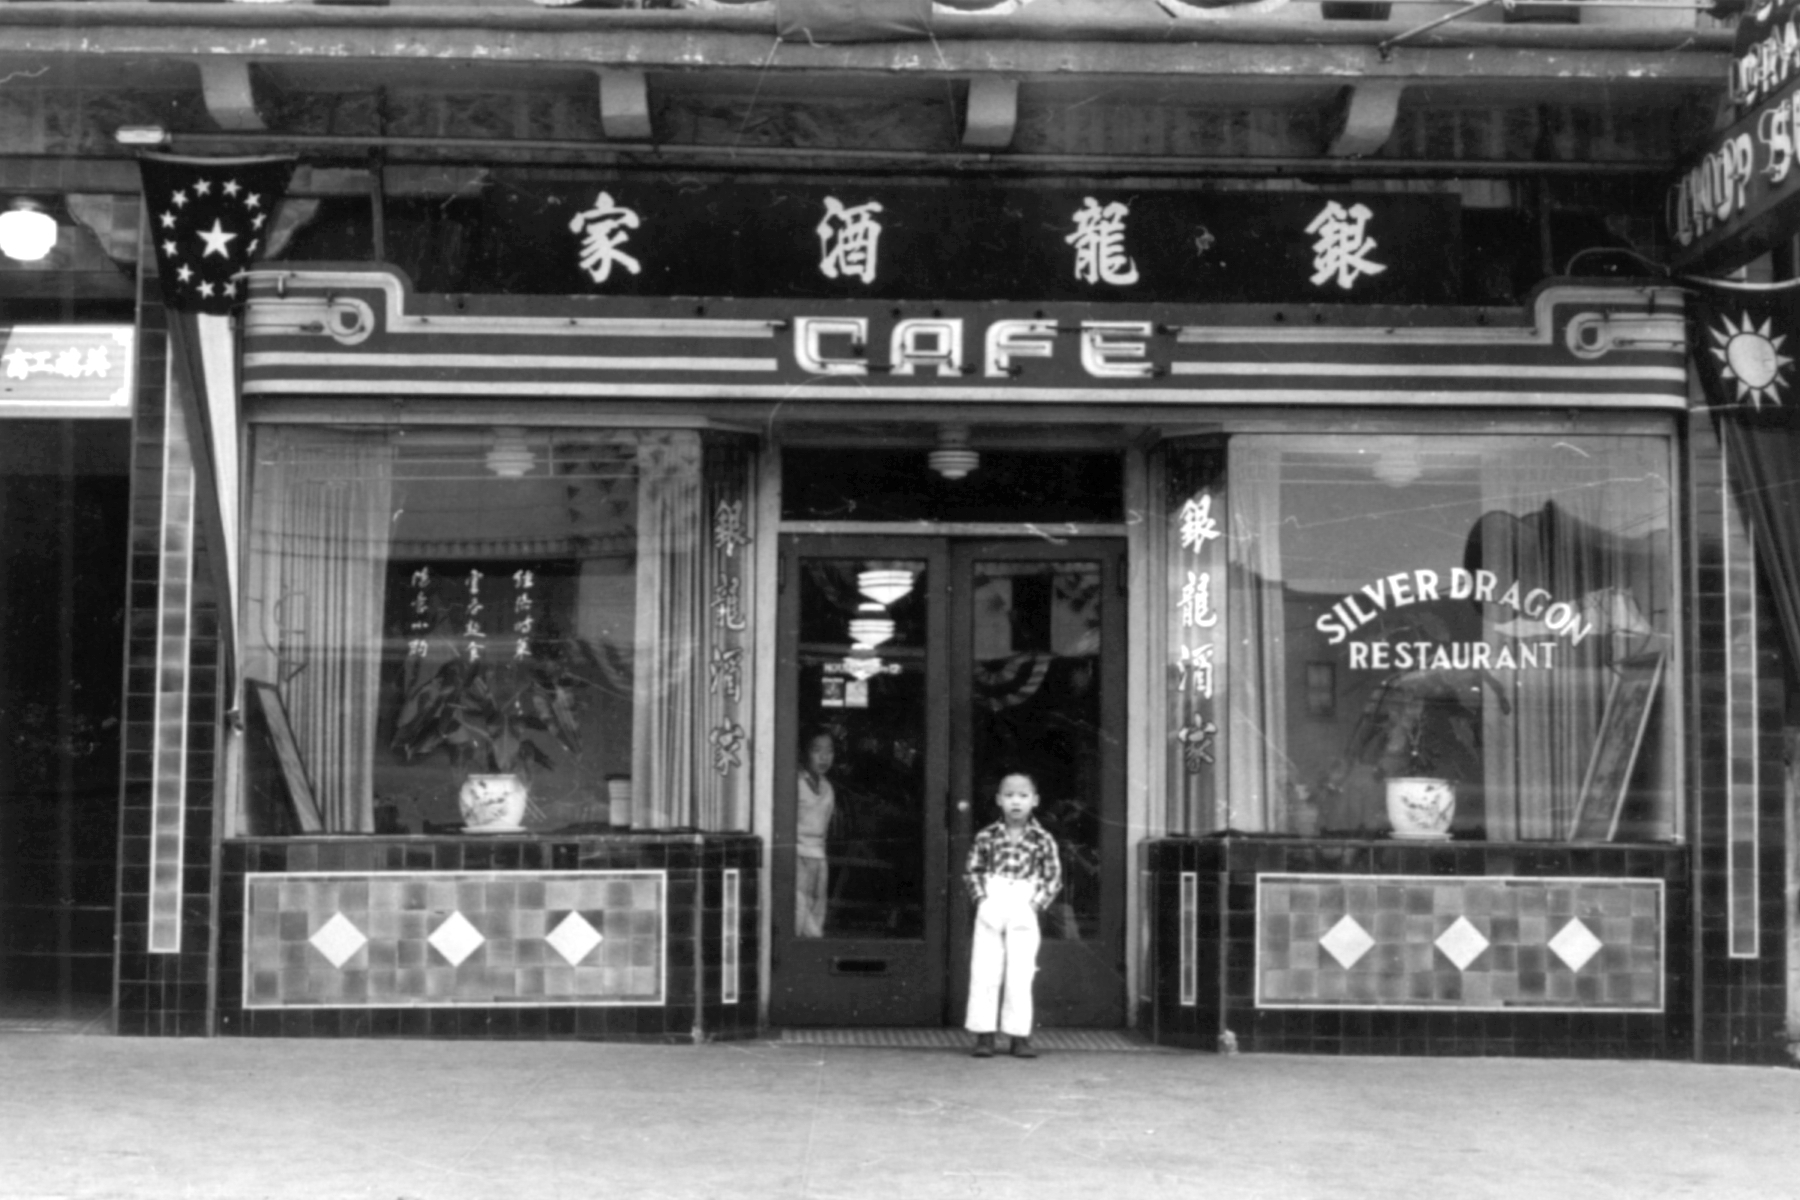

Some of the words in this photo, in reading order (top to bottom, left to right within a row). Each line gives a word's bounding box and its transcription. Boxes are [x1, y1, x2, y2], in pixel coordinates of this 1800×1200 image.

[793, 315, 1154, 379] CAFE
[1176, 493, 1222, 774] 銀龍酒家
[1314, 568, 1441, 646] SILVER
[1449, 566, 1593, 647] DRAGON
[1349, 641, 1558, 670] RESTAURANT
